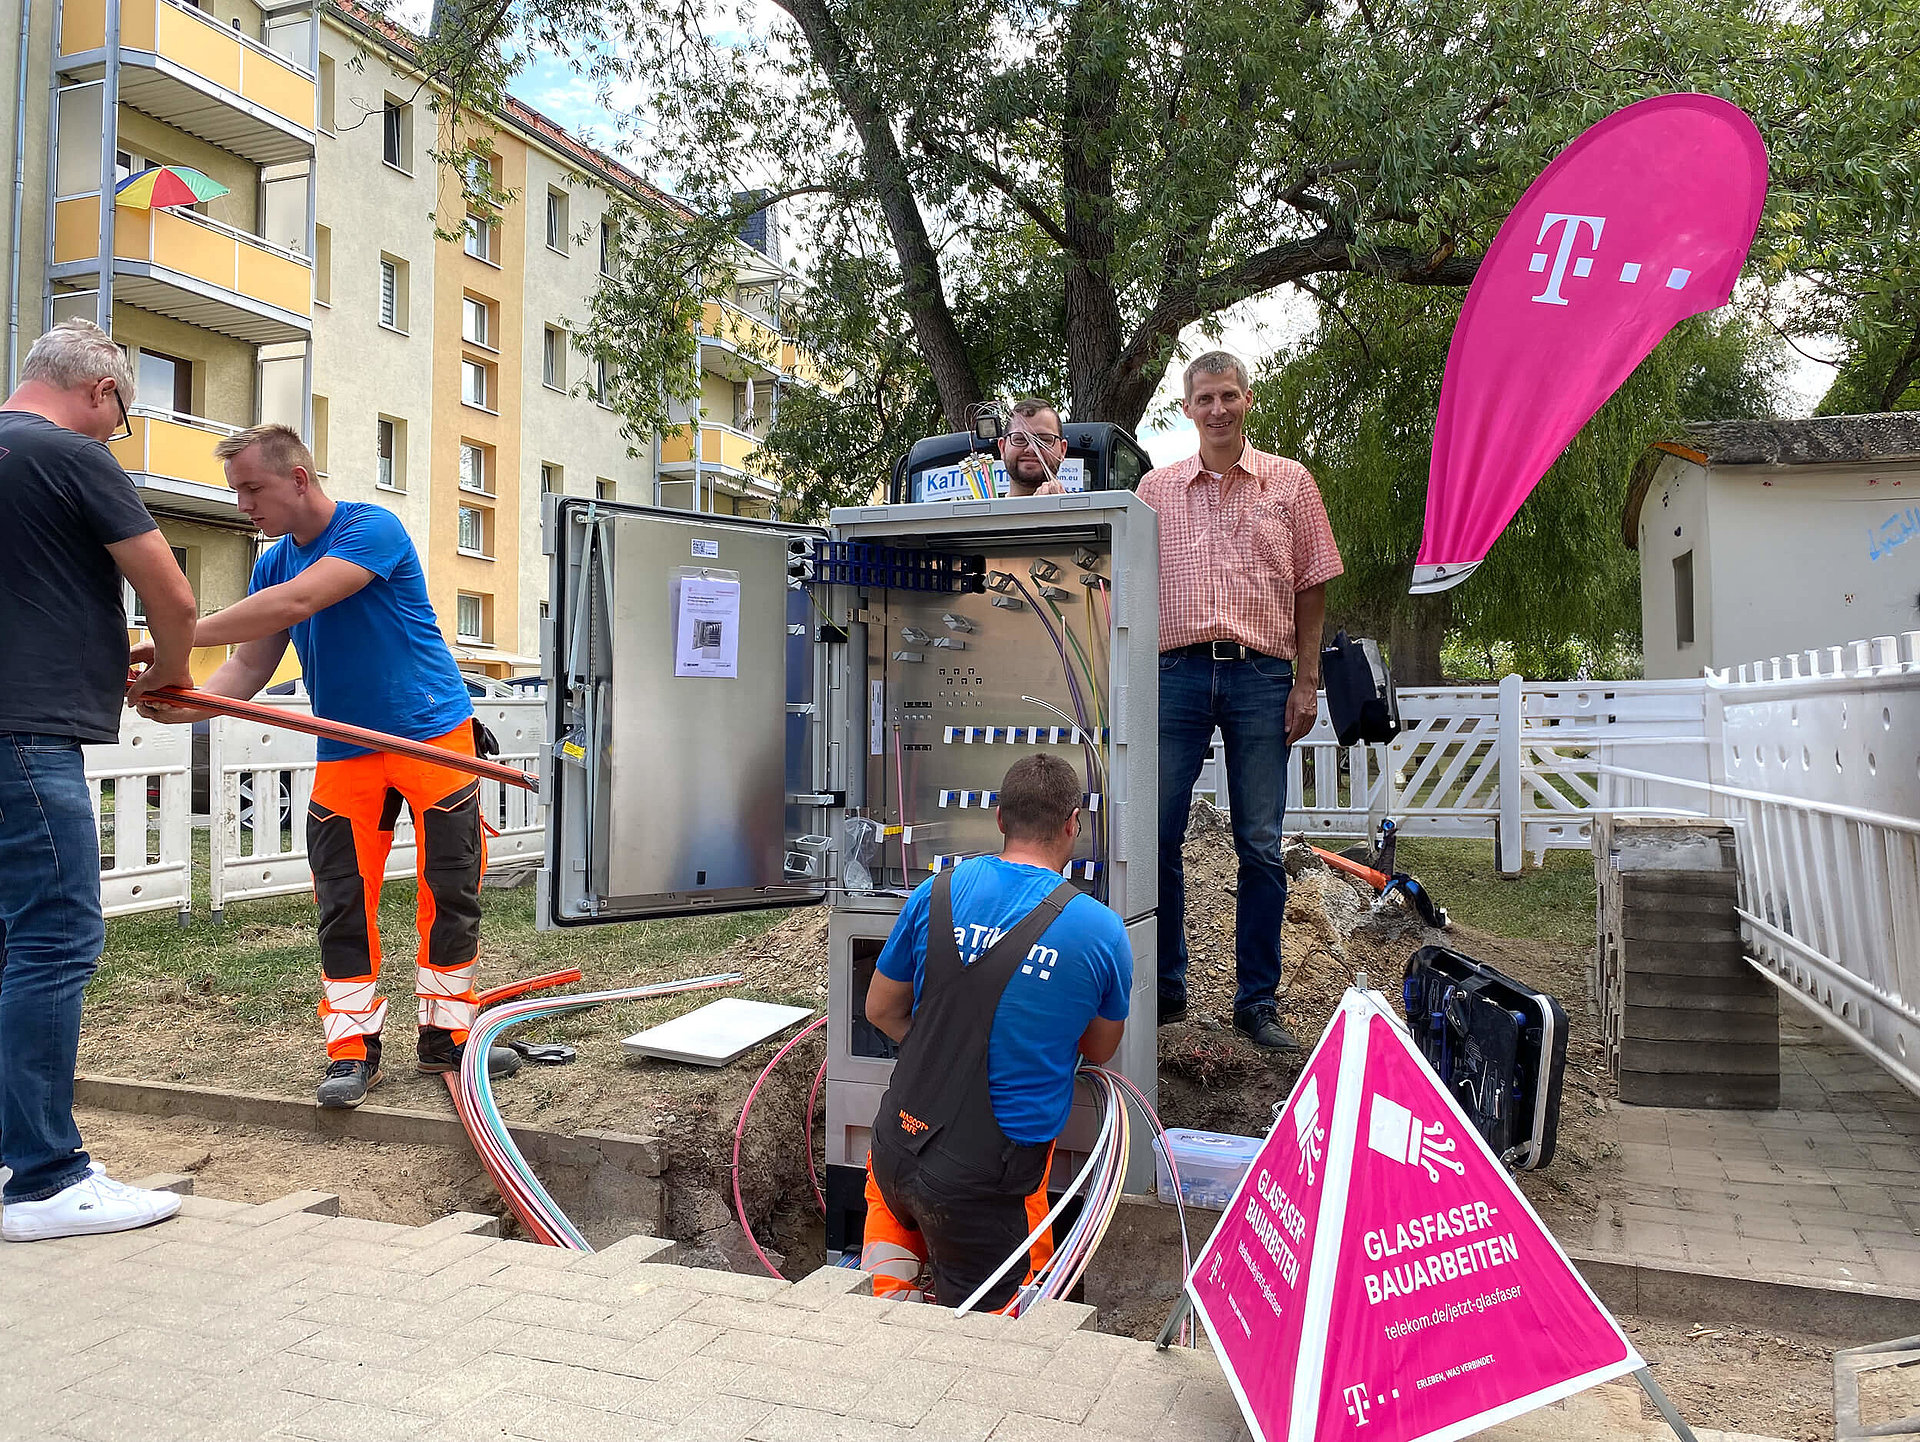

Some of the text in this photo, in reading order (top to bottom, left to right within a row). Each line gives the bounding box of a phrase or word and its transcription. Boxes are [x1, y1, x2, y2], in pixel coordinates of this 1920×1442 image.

[1258, 1168, 1306, 1245] GLASFASER-
[1363, 1201, 1499, 1261] GLASFASER-
[1245, 1196, 1301, 1290] BAUARBEITEN
[1364, 1233, 1520, 1305] BAUARBEITEN
[1384, 1286, 1522, 1340] telekom.de/jetzt-glasfaser
[1416, 1354, 1496, 1390] ERLEBEN, WAS VERBINDET.
